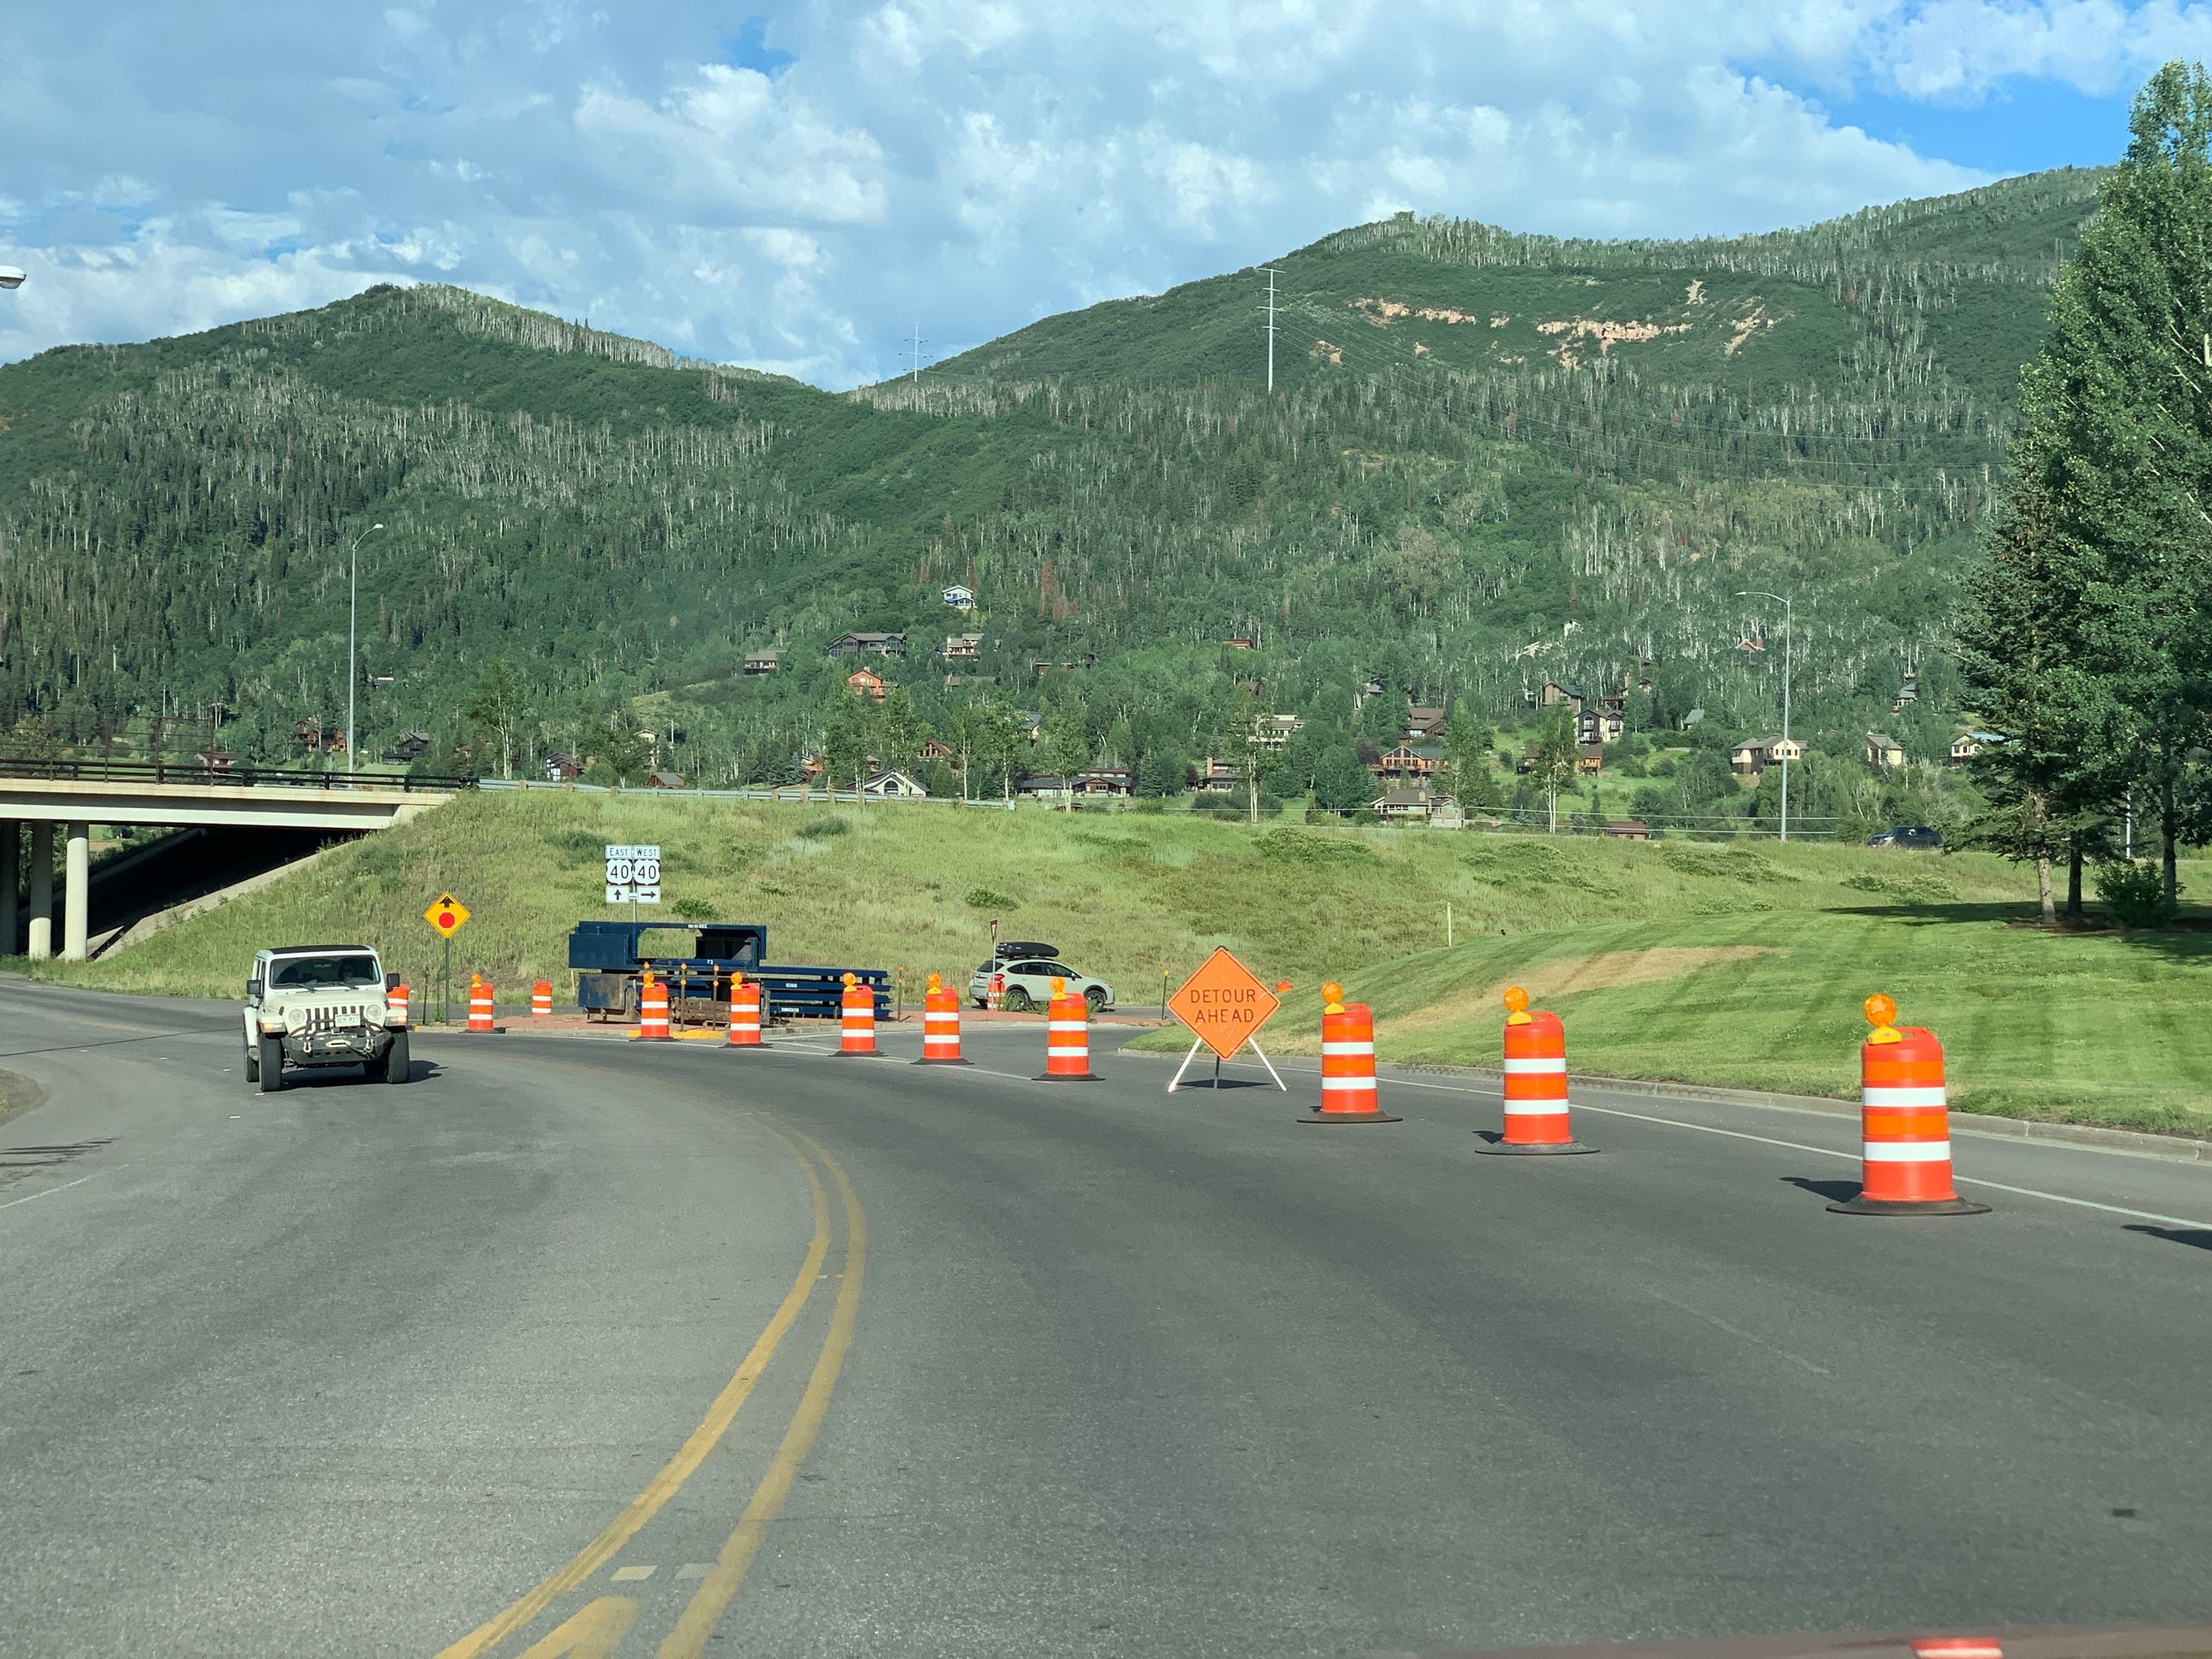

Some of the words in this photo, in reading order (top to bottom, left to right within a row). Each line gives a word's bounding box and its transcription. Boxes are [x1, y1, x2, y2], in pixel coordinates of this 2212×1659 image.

[609, 847, 629, 857] EAST
[636, 847, 657, 857] WEST
[610, 864, 629, 879] 40
[637, 865, 657, 880] 40
[1190, 989, 1256, 1004] DETOUR
[1194, 1008, 1254, 1023] AHEAD
